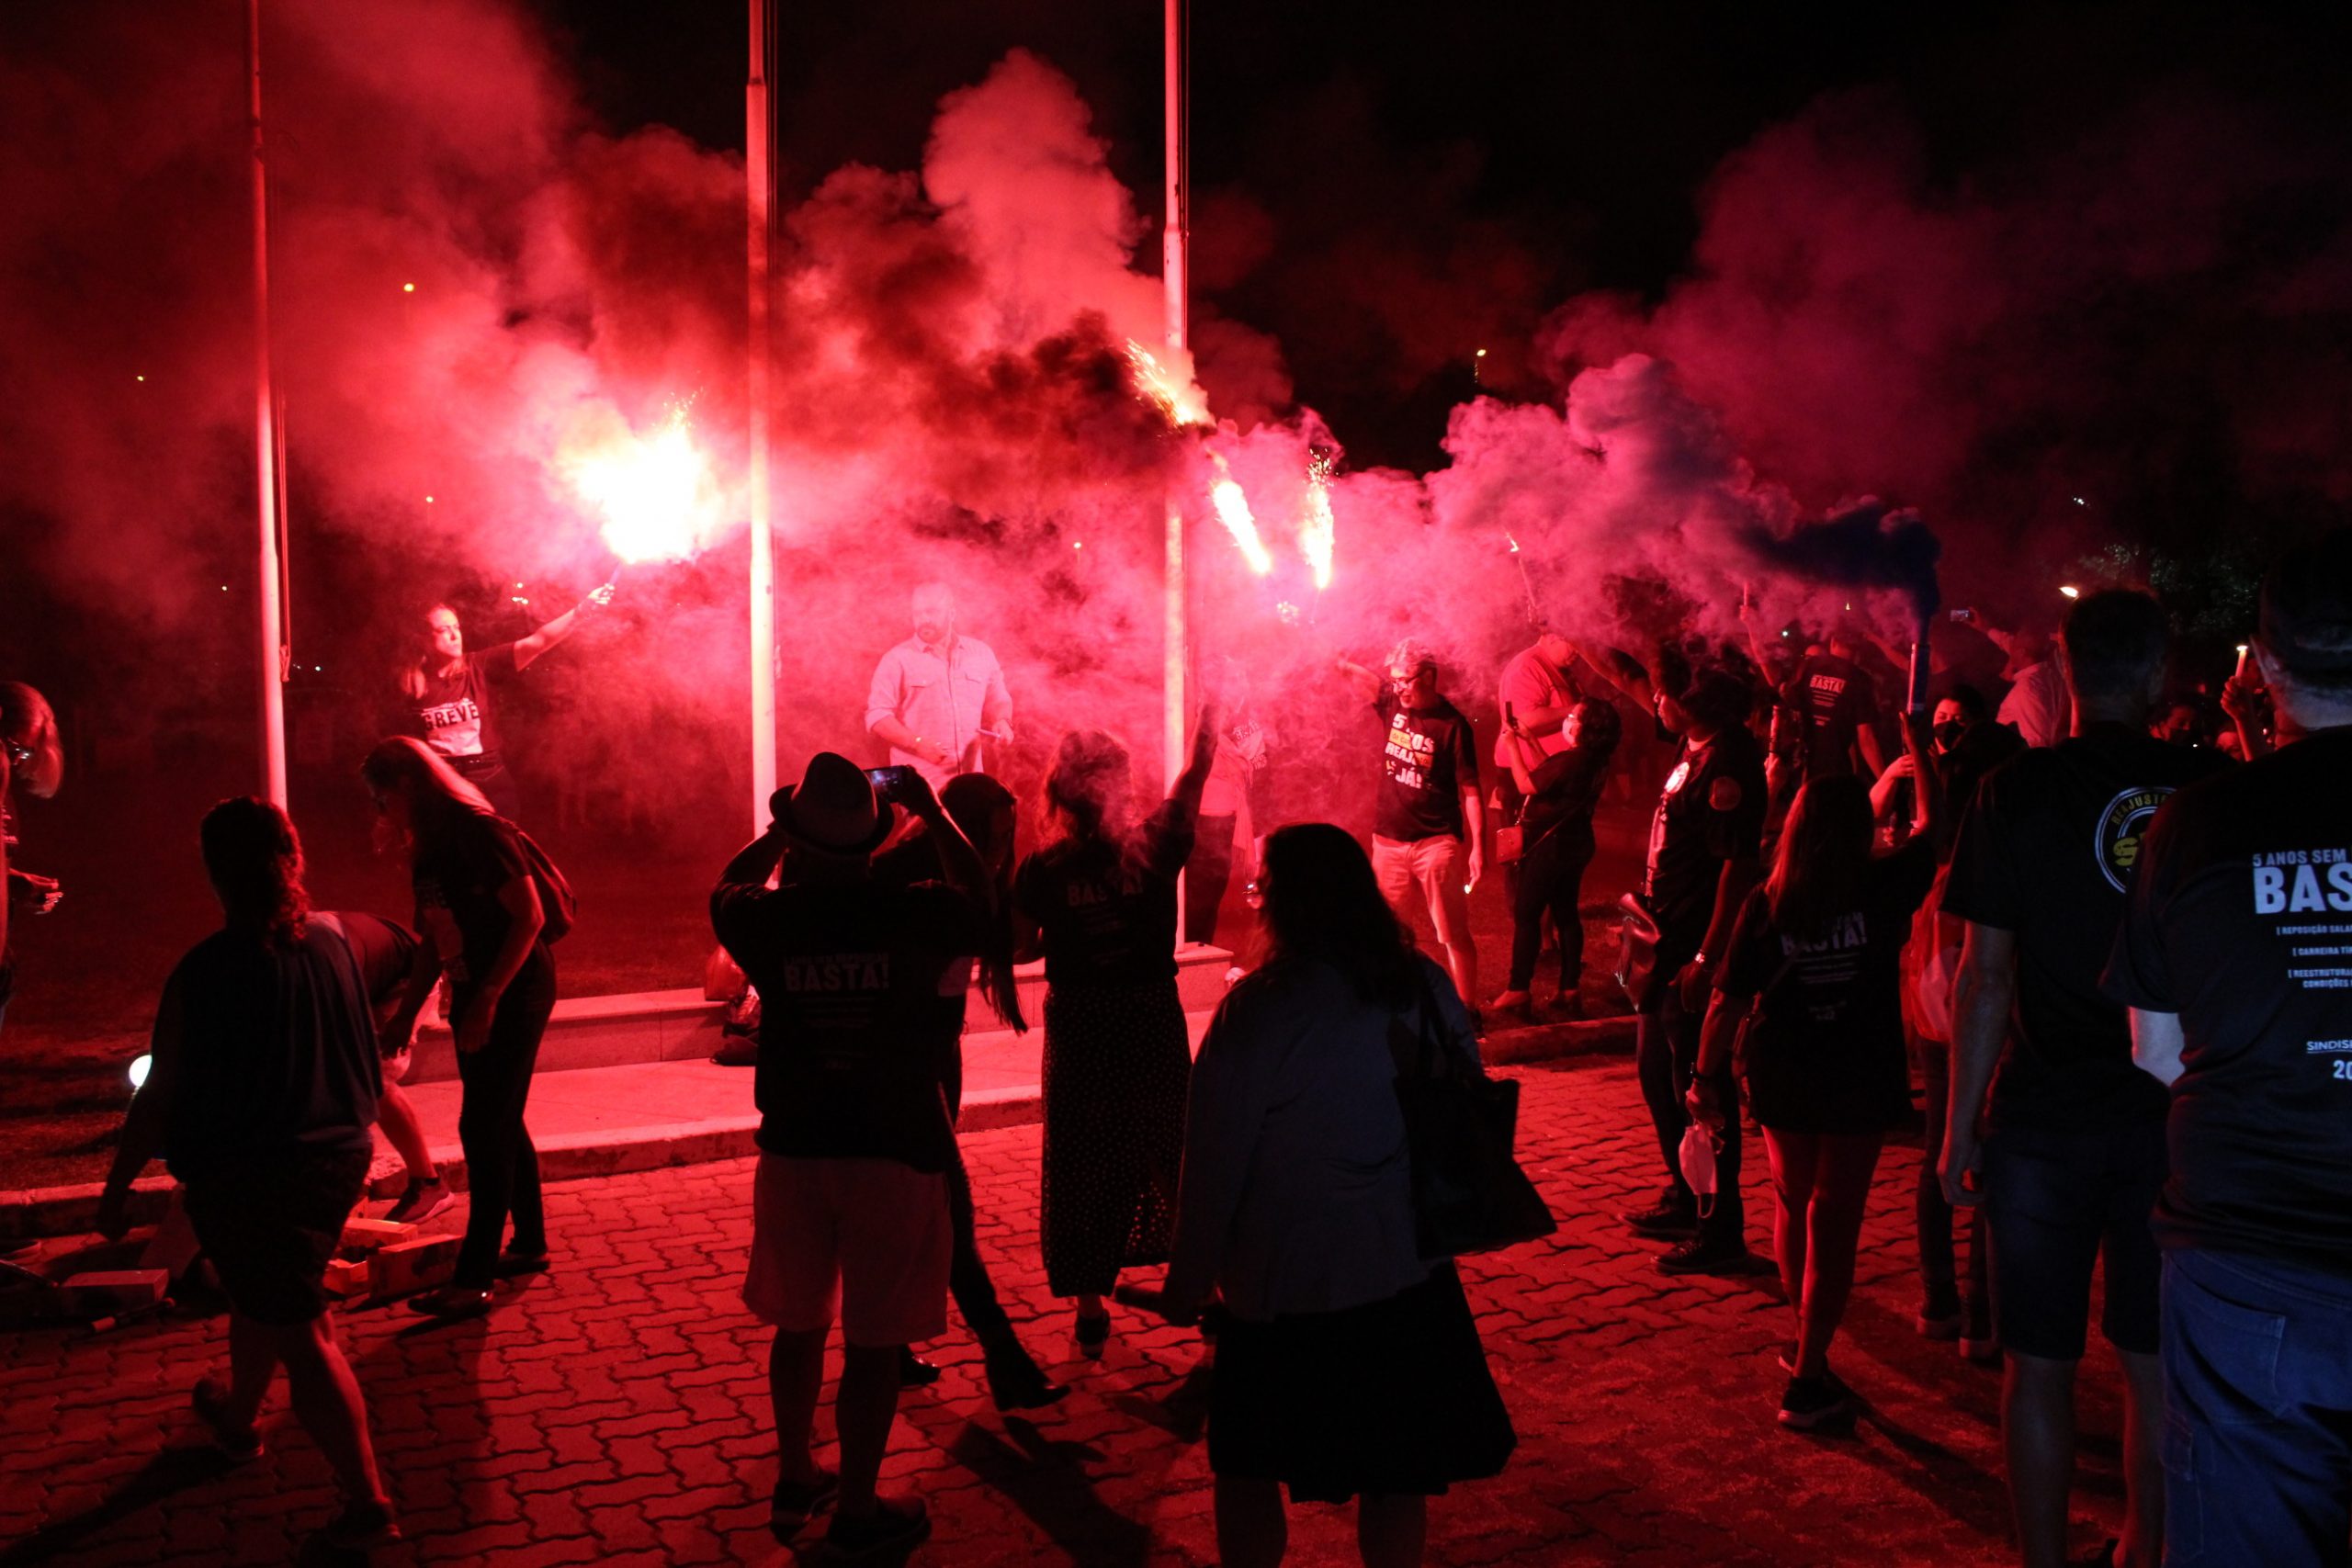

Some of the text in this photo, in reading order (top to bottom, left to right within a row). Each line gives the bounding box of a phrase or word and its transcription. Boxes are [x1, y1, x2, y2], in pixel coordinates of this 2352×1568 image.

[424, 705, 479, 731] GREVE
[1393, 713, 1408, 728] 5
[1385, 742, 1417, 766] REAJ
[1396, 767, 1423, 789] JÁ!
[2253, 848, 2347, 867] 5 ANOS SEM
[2254, 862, 2352, 915] BAS
[784, 953, 889, 992] BASTA!
